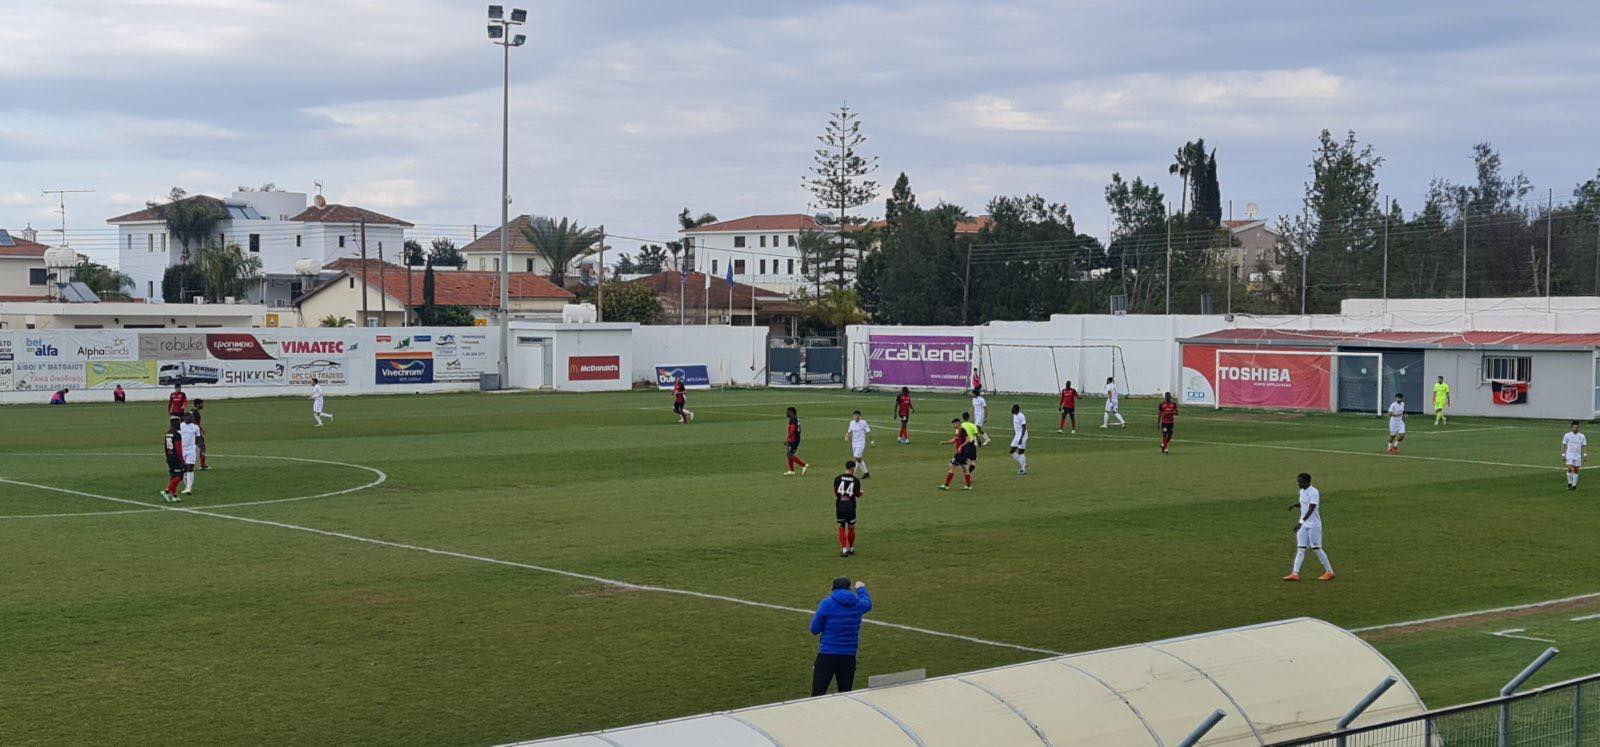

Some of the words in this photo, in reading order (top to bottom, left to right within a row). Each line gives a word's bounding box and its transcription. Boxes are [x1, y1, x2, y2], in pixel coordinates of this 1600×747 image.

[35, 344, 58, 356] alfa
[281, 341, 344, 354] VIMATEC
[885, 344, 973, 362] cablenet
[580, 365, 618, 373] McDonald's
[1218, 366, 1291, 382] TOSHIBA
[225, 370, 274, 383] SHIKKIS
[837, 481, 854, 497] 44
